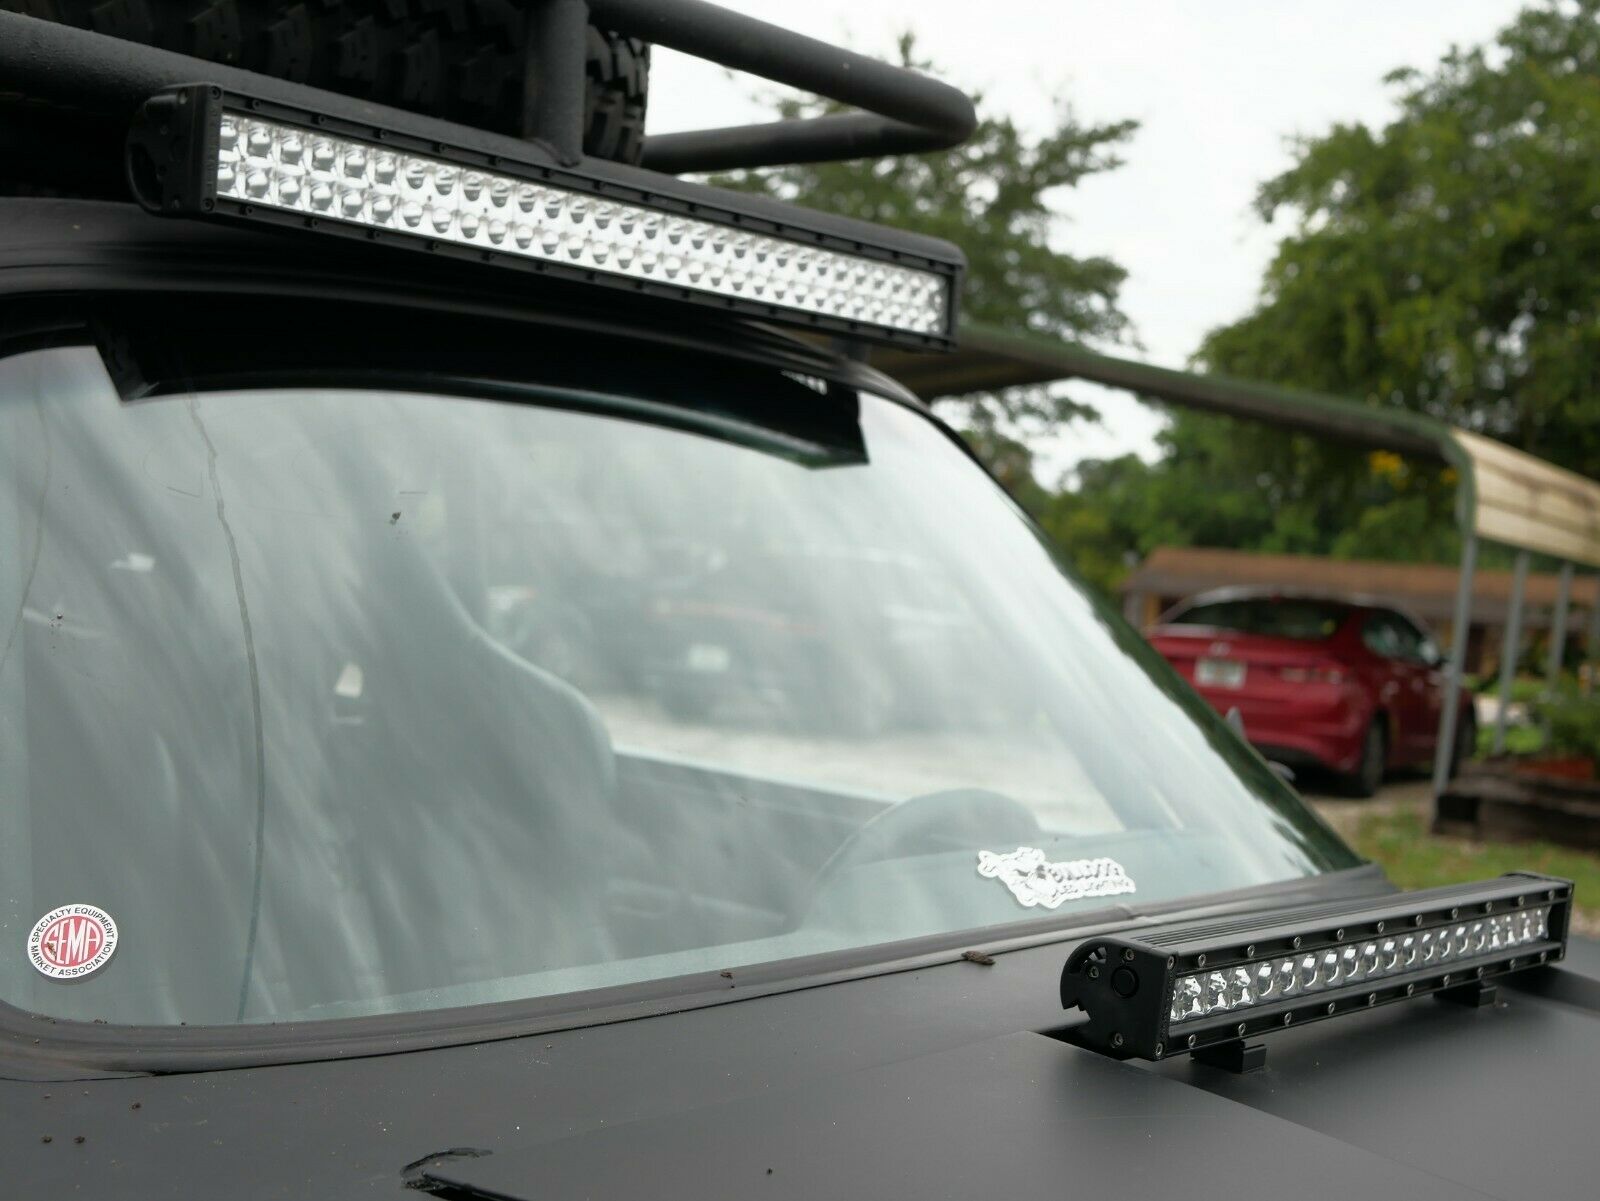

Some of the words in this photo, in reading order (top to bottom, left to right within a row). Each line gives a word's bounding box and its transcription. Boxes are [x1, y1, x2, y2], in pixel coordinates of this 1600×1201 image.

[31, 907, 72, 943] SPECIALTY
[74, 907, 115, 938] EQUIPMENT
[43, 918, 101, 964] SEMA
[31, 945, 57, 974] MARKET
[58, 941, 113, 976] ASSOCIATION
